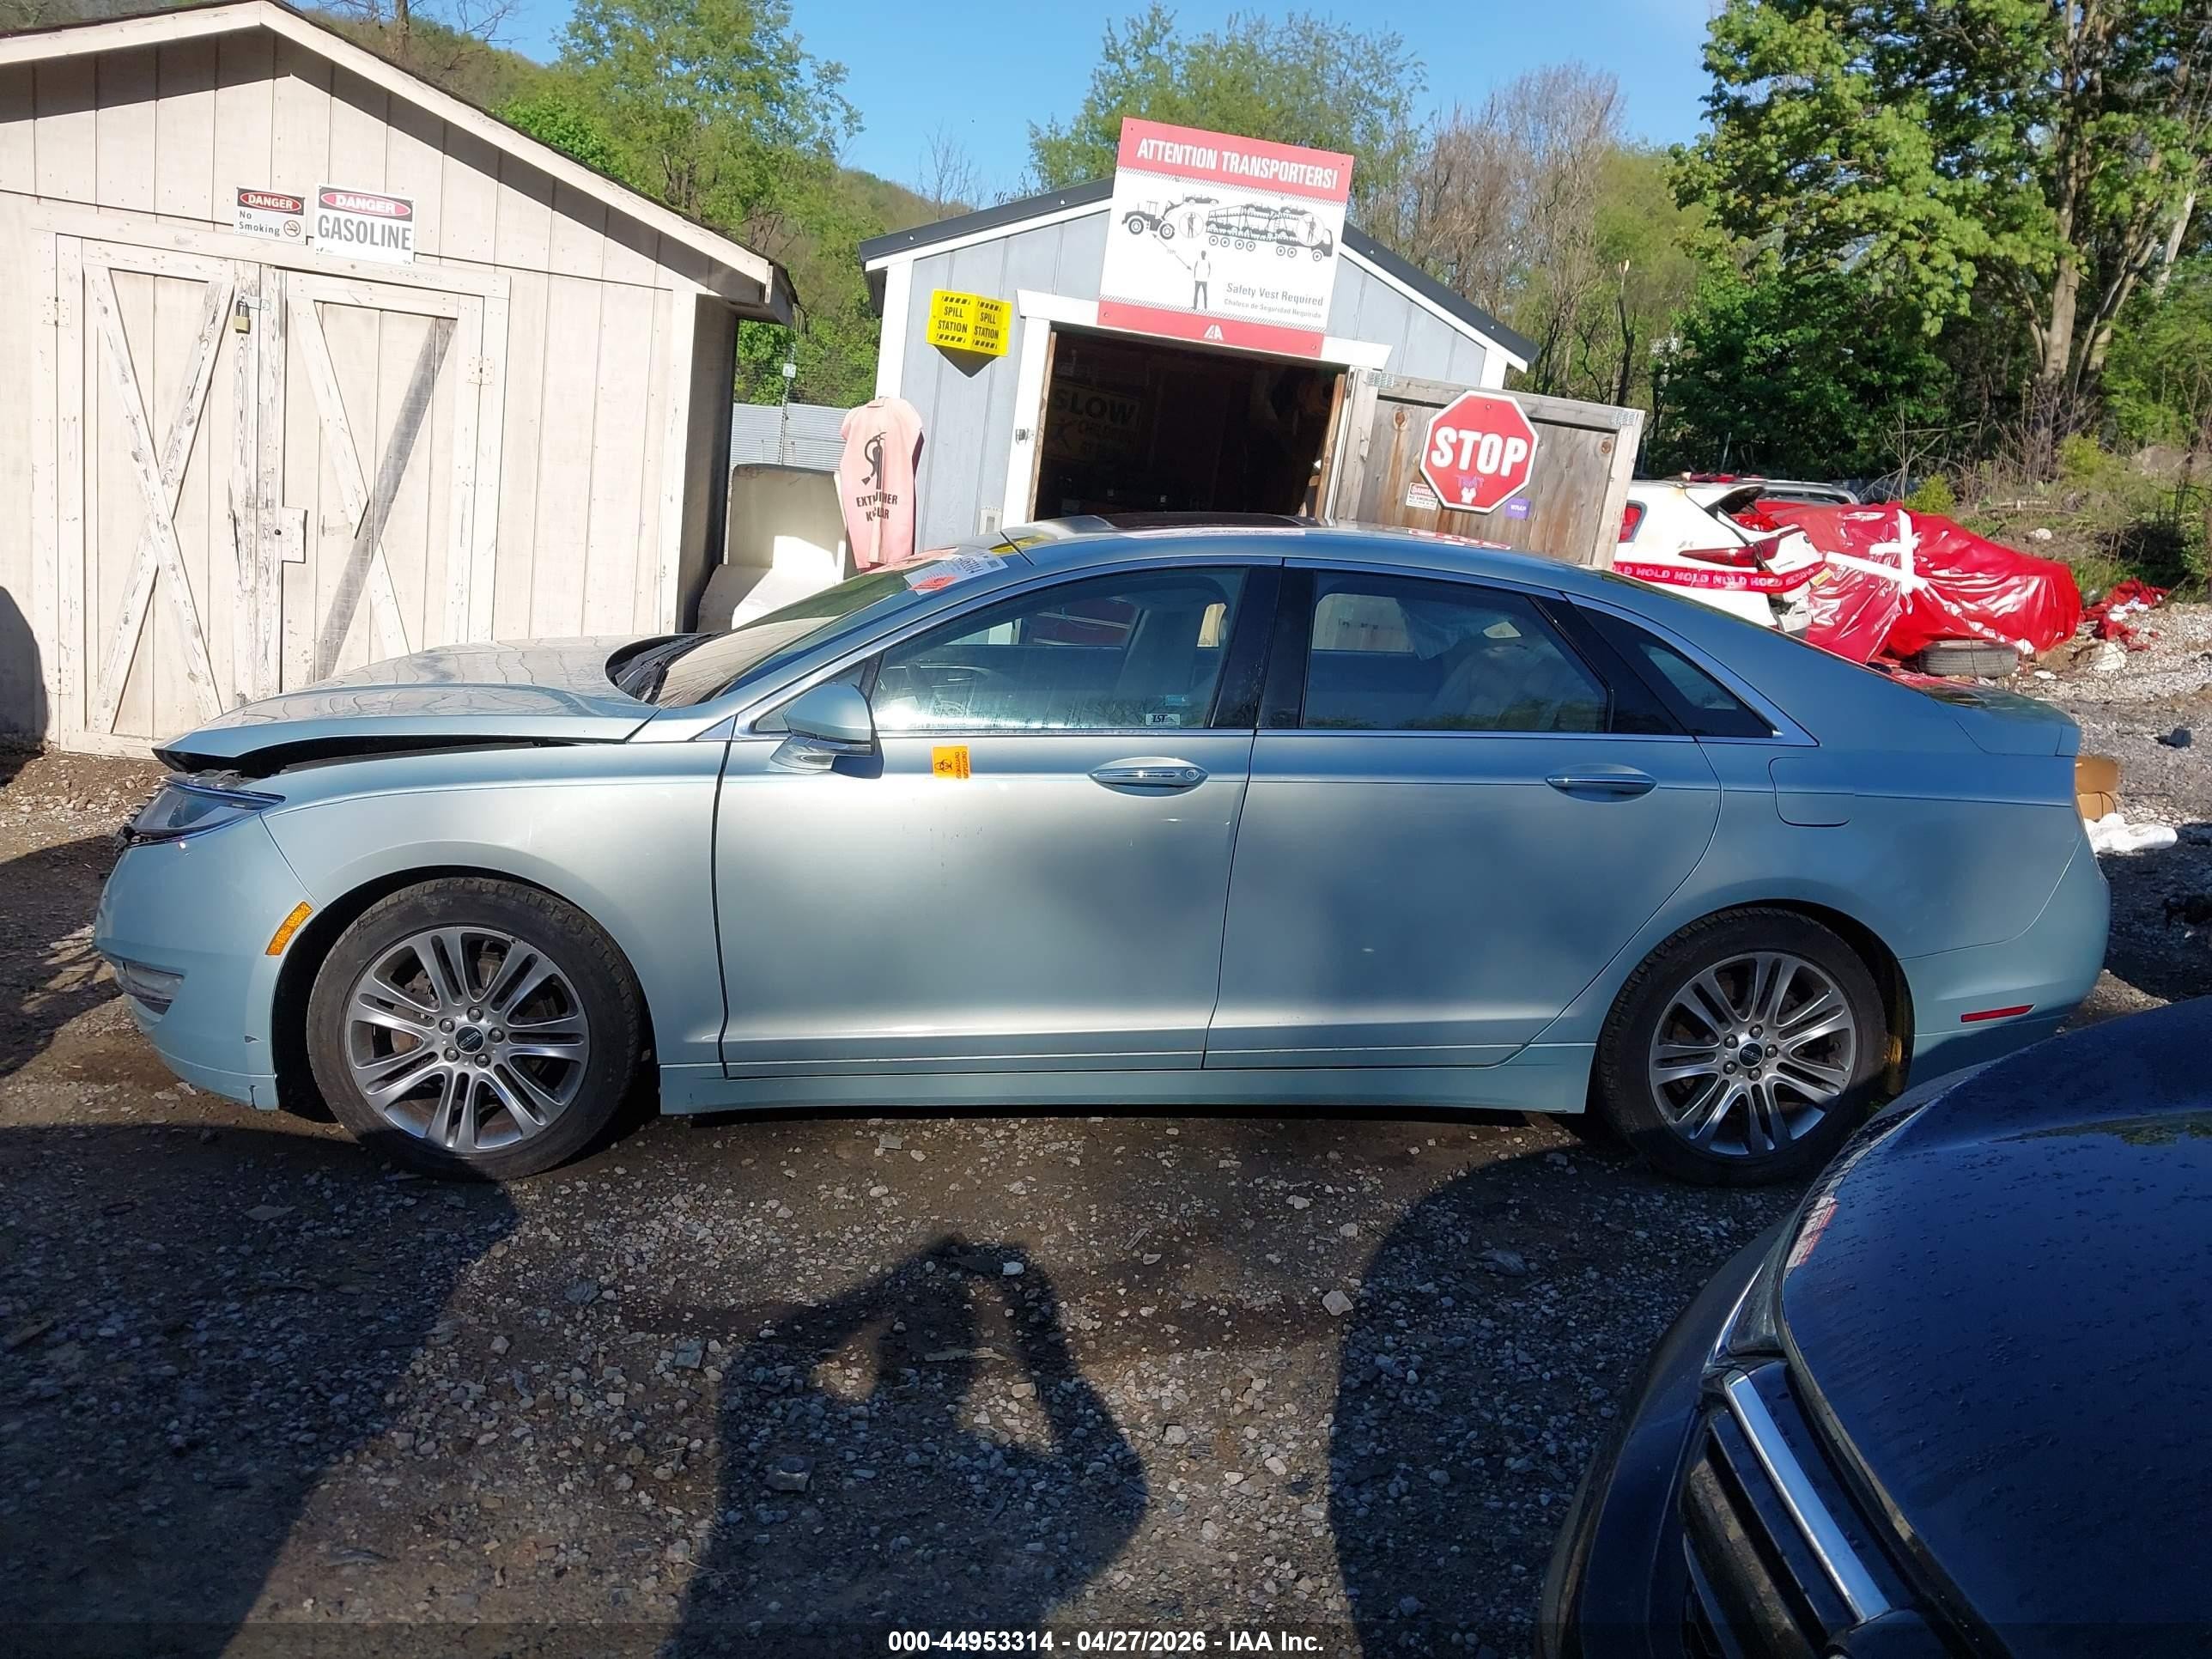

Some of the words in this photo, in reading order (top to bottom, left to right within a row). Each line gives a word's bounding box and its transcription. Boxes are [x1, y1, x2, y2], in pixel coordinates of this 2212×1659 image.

[1137, 137, 1218, 170] ATTENTION
[1222, 150, 1338, 190] TRANSPORTERS!
[248, 194, 293, 210] DANGER
[336, 193, 396, 215] DANGER
[239, 210, 252, 220] No
[239, 221, 280, 237] Smoking
[318, 214, 411, 252] GASOLINE
[1226, 283, 1255, 298] Safety
[1259, 286, 1279, 300] Vest
[1281, 290, 1323, 307] Required
[944, 306, 963, 319] SPILL
[980, 312, 996, 325] SPILL
[937, 319, 968, 333] STATION
[974, 325, 999, 340] STATION
[1054, 389, 1137, 426] SLOW
[1430, 426, 1528, 477] STOP
[1636, 567, 1671, 579] HOLD
[1674, 570, 1710, 583] HOLD
